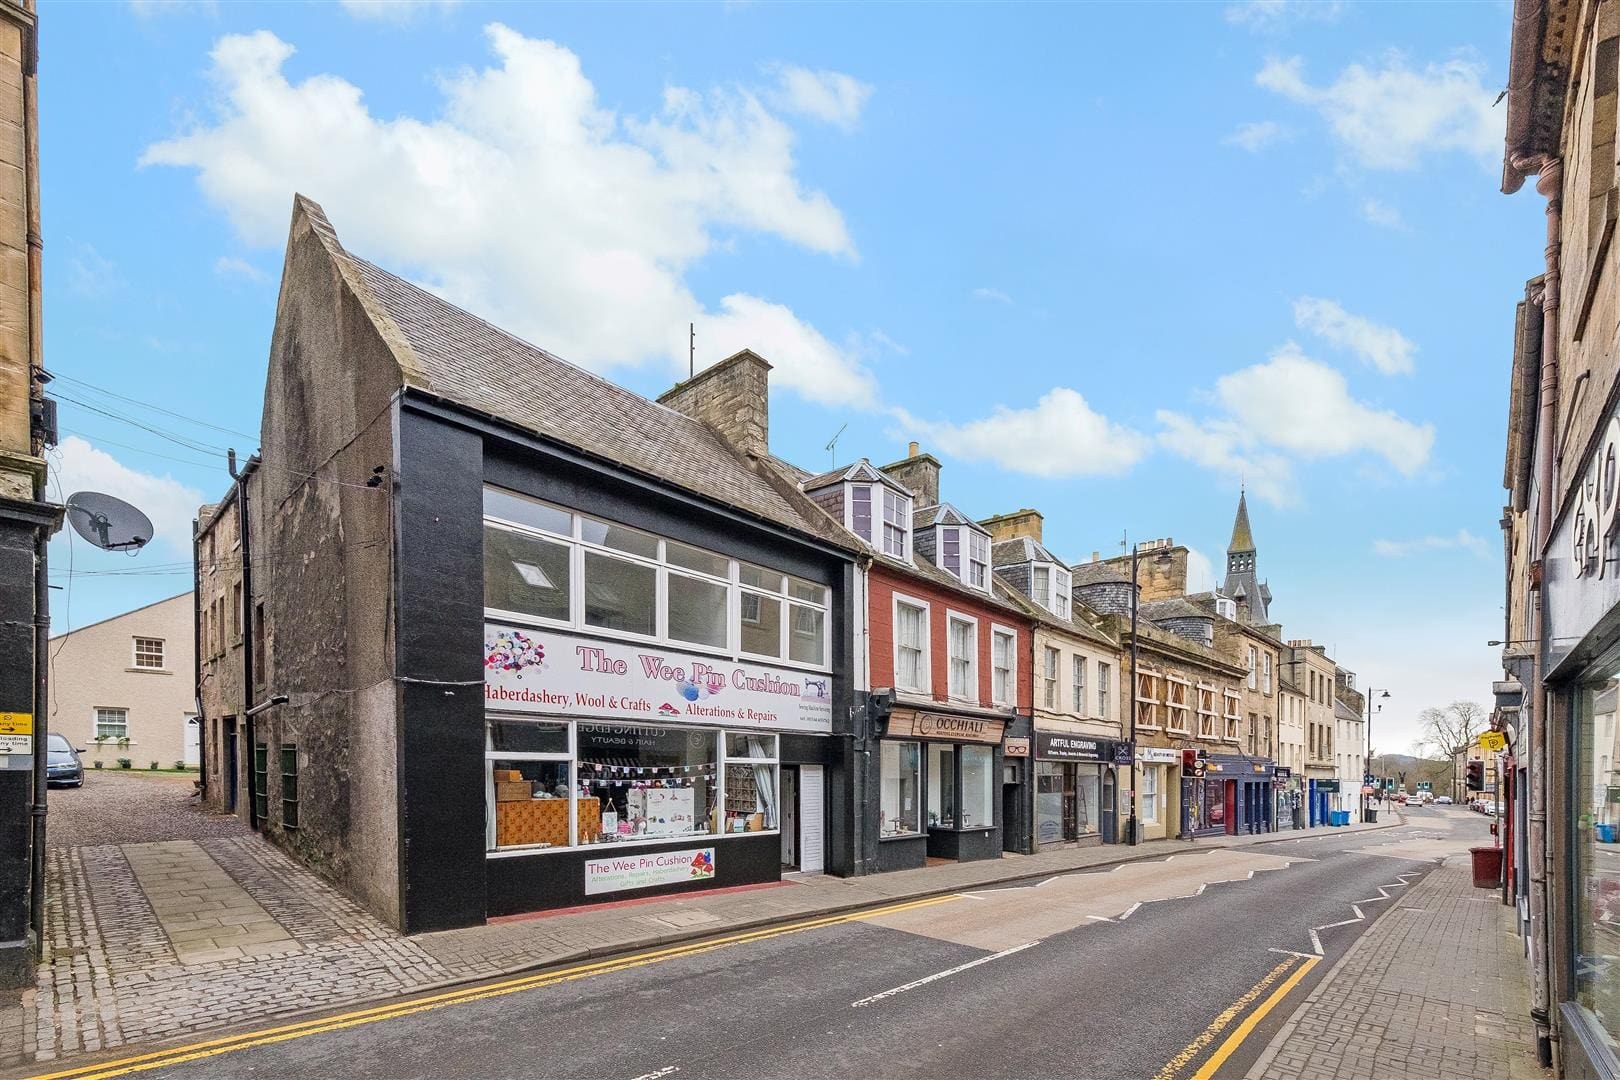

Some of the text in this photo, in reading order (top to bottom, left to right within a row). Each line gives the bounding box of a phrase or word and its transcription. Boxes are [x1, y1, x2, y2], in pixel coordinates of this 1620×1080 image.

[576, 645, 800, 697] The Wee Pin Cushion
[576, 692, 605, 708] Wool
[608, 696, 618, 709] &
[621, 697, 651, 711] Crafts
[685, 703, 777, 725] Alterations & Repairs
[936, 718, 983, 732] OCCHIALI
[1050, 738, 1097, 750] ARTFUL ENGRAVING
[588, 855, 692, 875] The Wee Pin Cushion
